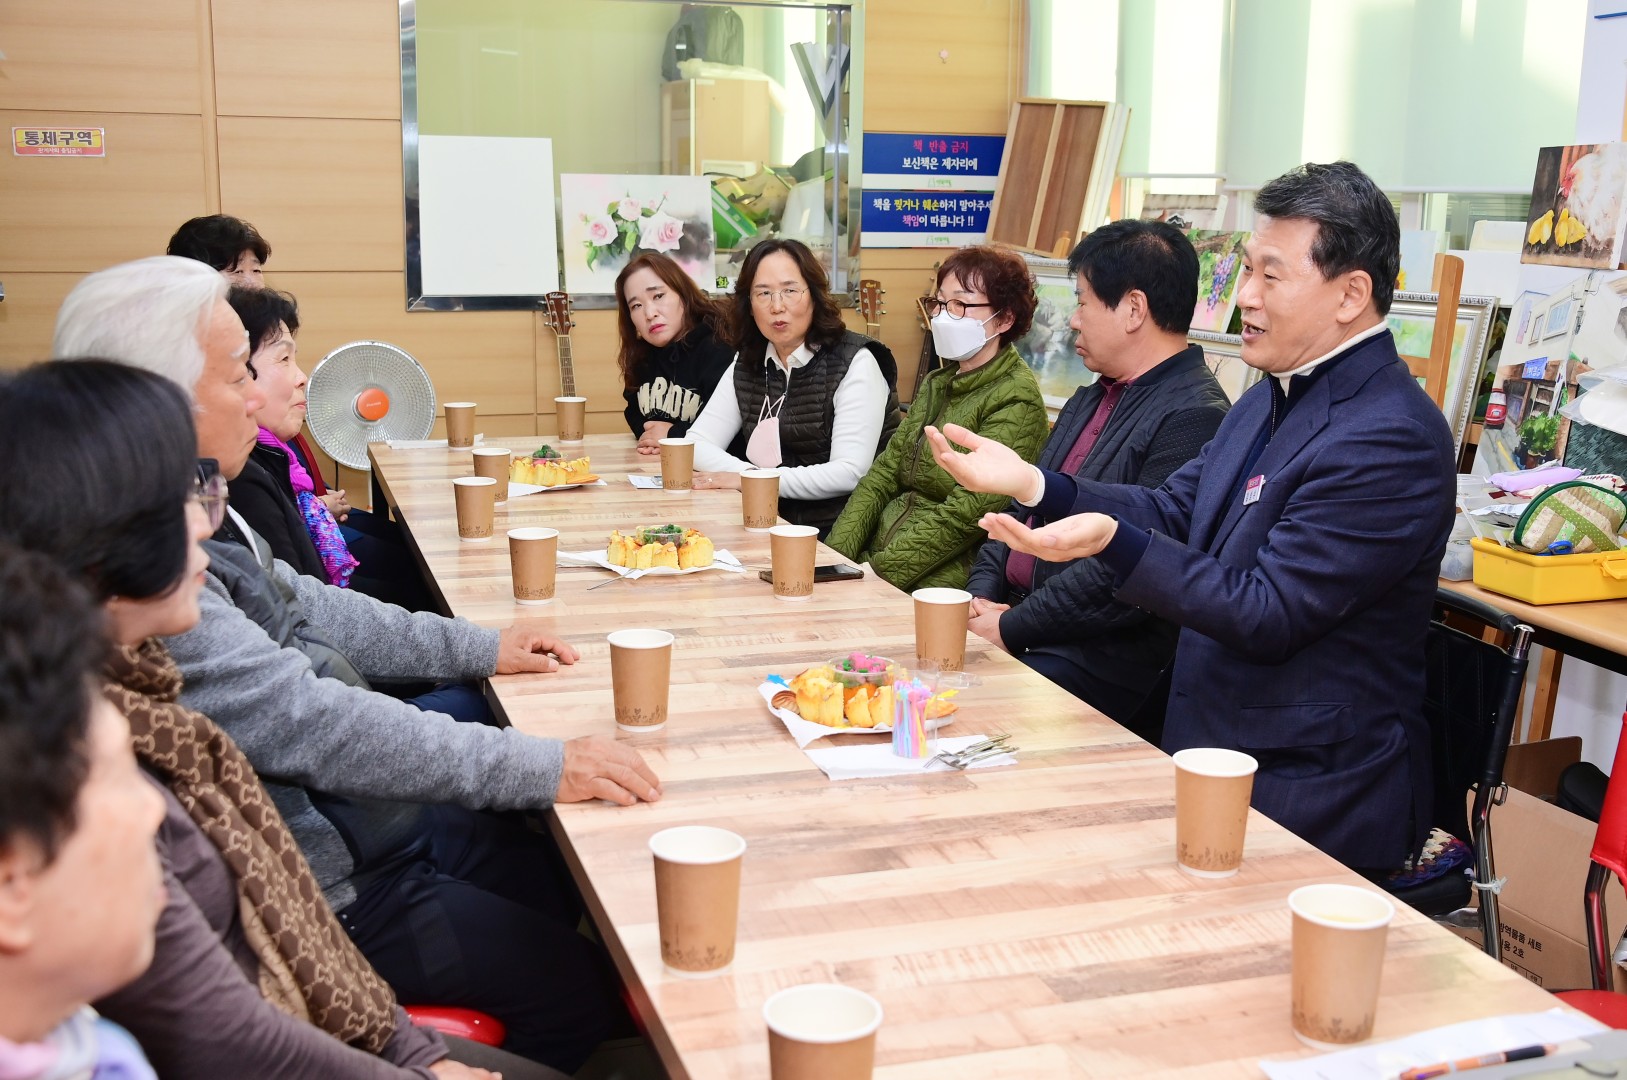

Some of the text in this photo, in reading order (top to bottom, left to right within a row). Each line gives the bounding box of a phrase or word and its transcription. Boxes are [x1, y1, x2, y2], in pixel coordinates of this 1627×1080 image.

[24, 131, 92, 146] 통제구역
[913, 139, 969, 154] 책 반출 금지
[902, 156, 978, 171] 보신책은 제자리에
[873, 198, 891, 211] 책을
[922, 198, 957, 212] 훼손하지
[902, 214, 928, 227] 책임이
[930, 214, 965, 228] 따릅니다
[1513, 946, 1525, 958] 2호
[1528, 938, 1542, 952] 세트
